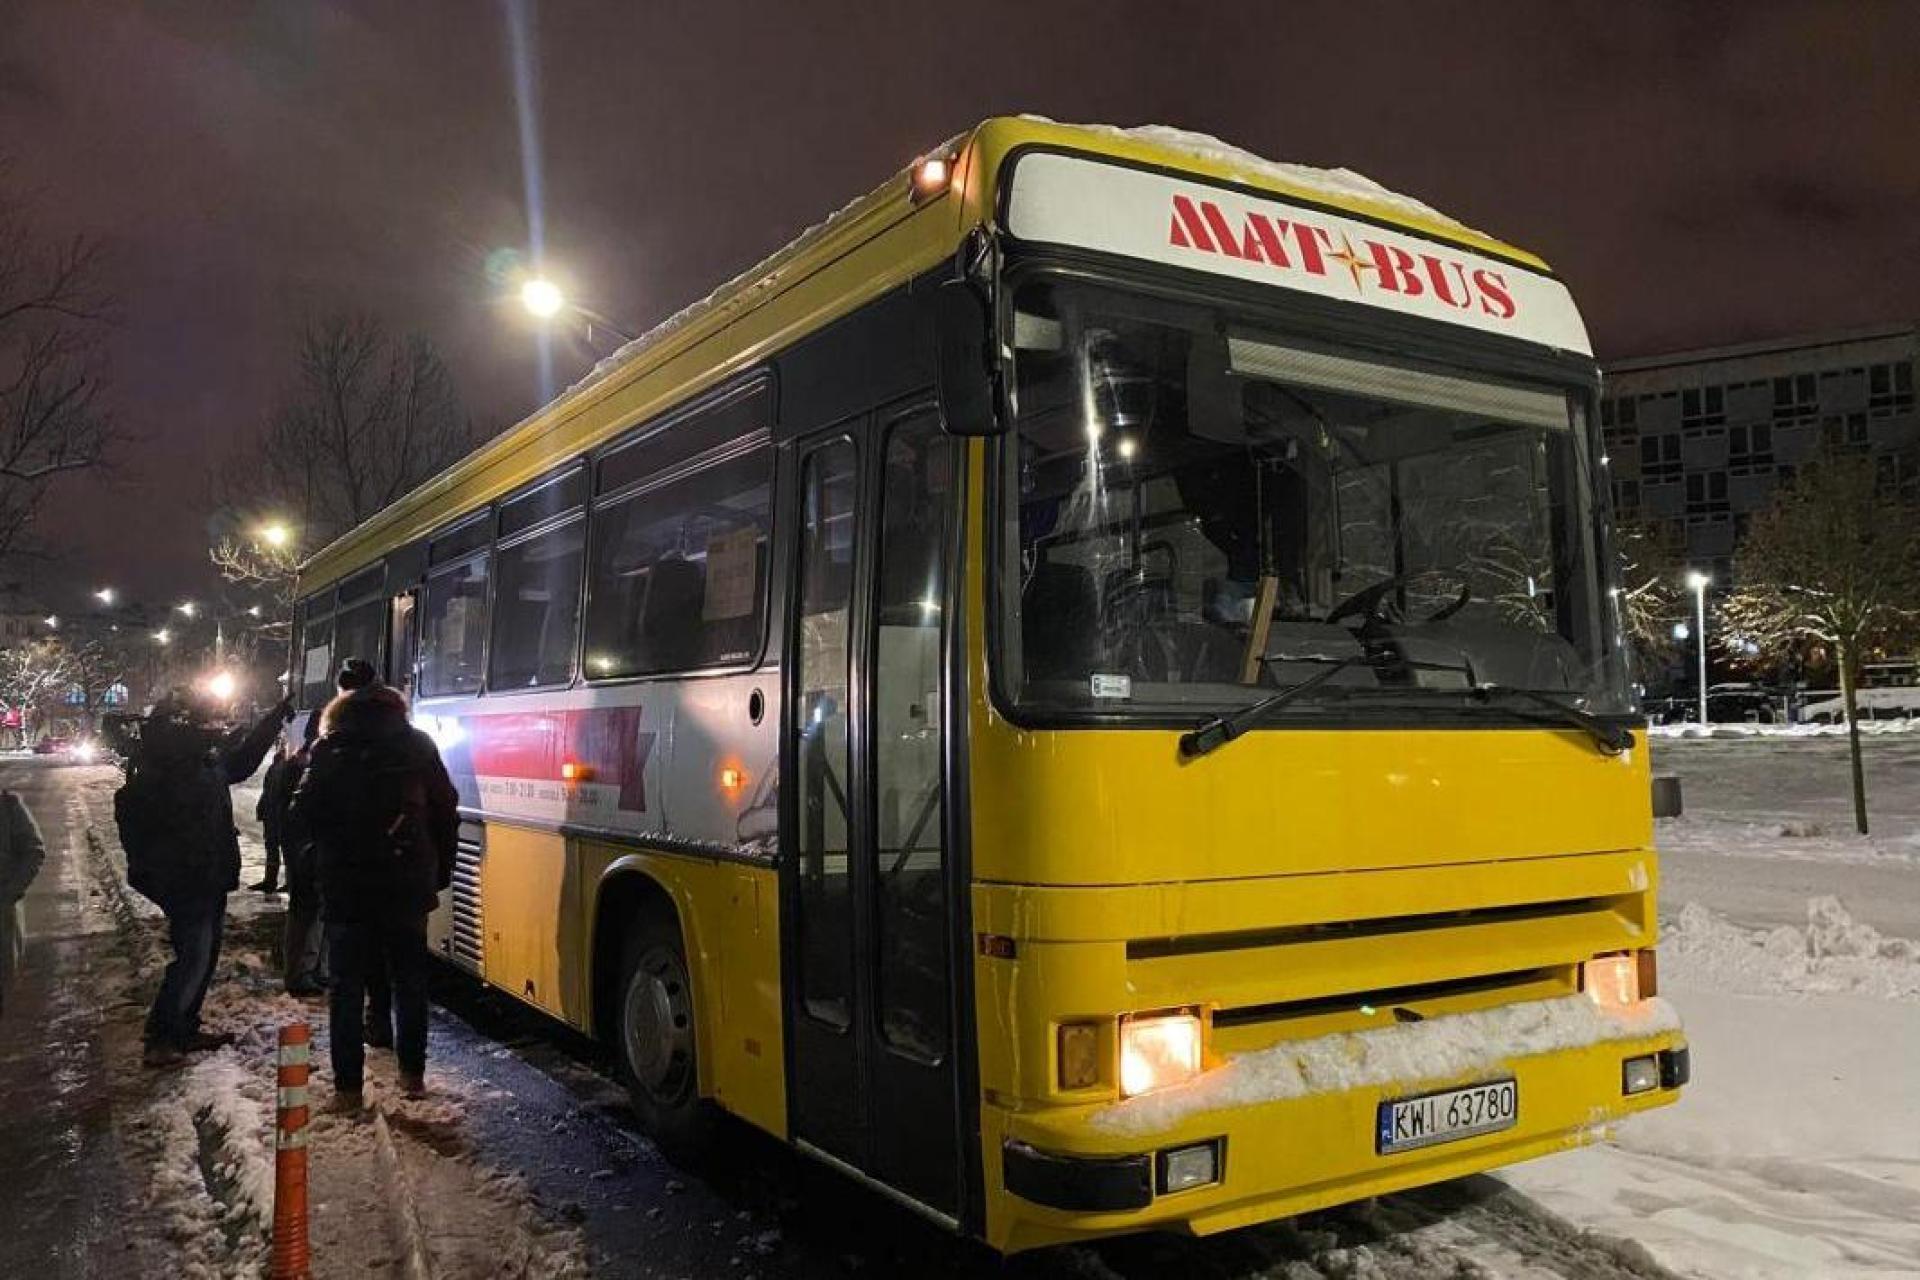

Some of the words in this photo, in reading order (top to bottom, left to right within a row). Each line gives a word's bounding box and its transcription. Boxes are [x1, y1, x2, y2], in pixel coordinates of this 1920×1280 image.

[1169, 194, 1333, 276] MAT
[1364, 239, 1516, 320] BUS
[1395, 1101, 1435, 1140] KWI
[1447, 1086, 1513, 1128] 63780
